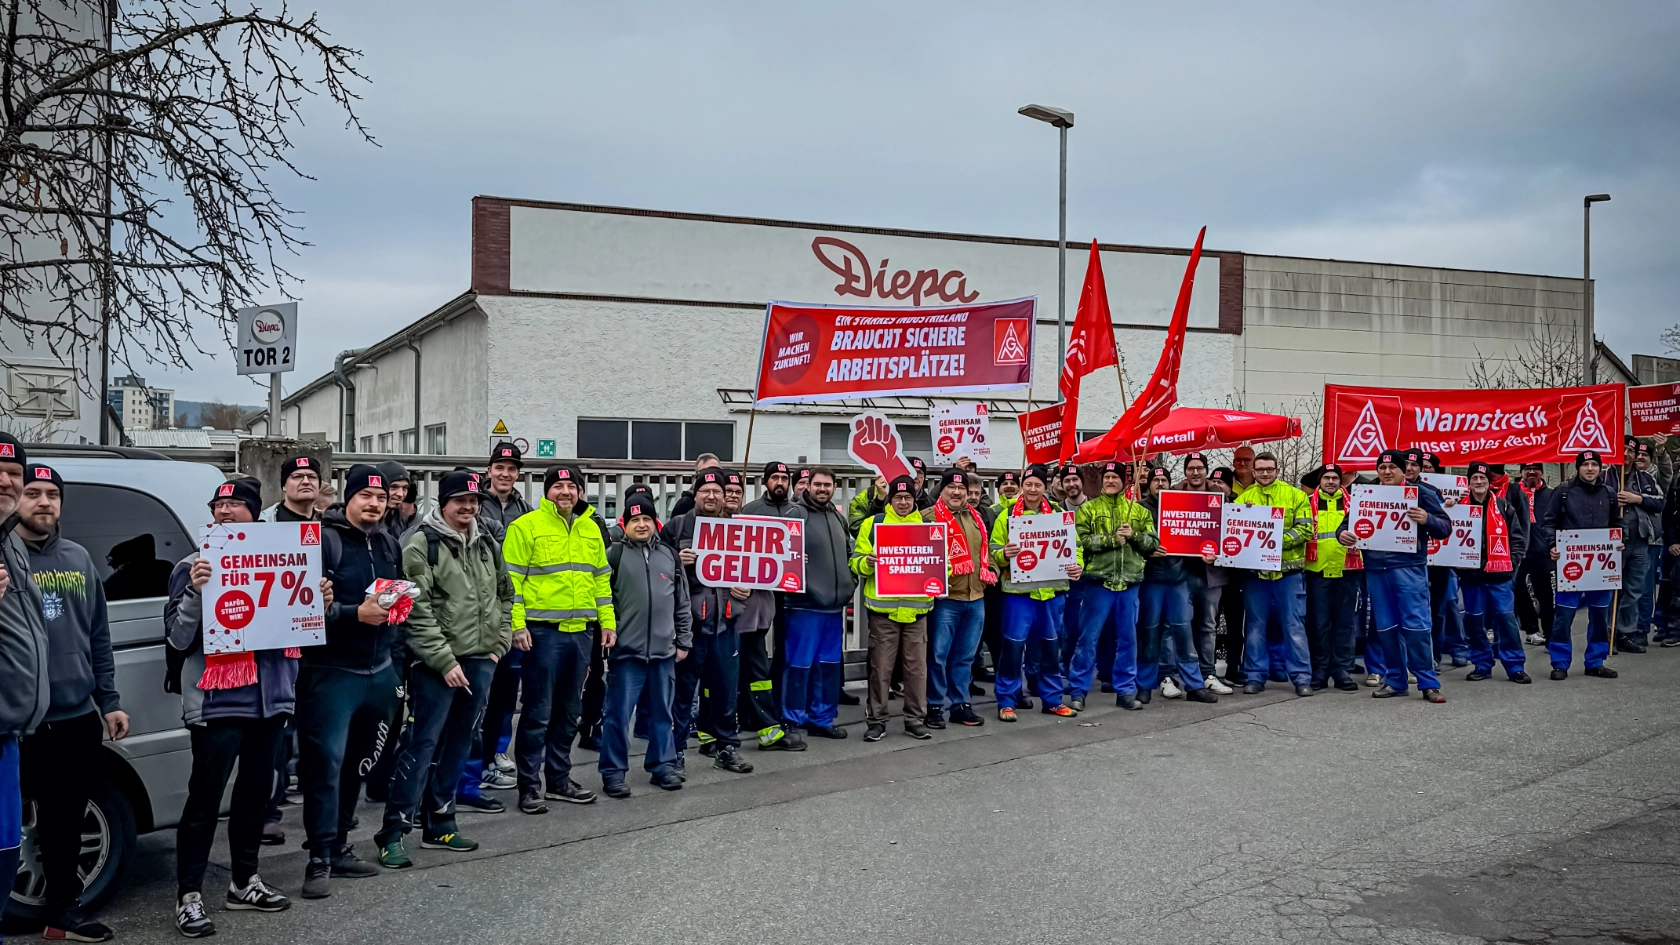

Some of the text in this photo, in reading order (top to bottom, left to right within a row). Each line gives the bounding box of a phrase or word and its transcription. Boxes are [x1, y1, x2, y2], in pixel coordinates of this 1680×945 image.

[811, 236, 980, 306] Diepa
[835, 315, 853, 326] EIN
[789, 332, 804, 344] WIR
[830, 326, 966, 351] BRAUCHT SICHERE
[777, 342, 810, 358] MACHEN
[243, 346, 290, 367] TOR 2
[772, 353, 811, 371] ZUKUNFT!
[825, 350, 965, 383] ARBEITSPLÄTZE!
[1631, 399, 1676, 409] INVESTIEREN
[939, 418, 981, 427] GEMEINSAM
[1415, 405, 1548, 432] Warnstreik
[1640, 414, 1670, 422] SPAREN.
[1153, 430, 1195, 445] Metall
[1461, 437, 1502, 455] gutes
[1503, 432, 1548, 448] Recht
[1359, 501, 1408, 510] GEMEINSAM
[1162, 510, 1211, 520] INVESTIEREN
[1358, 508, 1373, 517] FÜR
[1162, 519, 1220, 529] STATT KAPUTT-
[1227, 519, 1275, 530] GEMEINSAM
[1019, 529, 1068, 540] GEMEINSAM
[1170, 528, 1202, 536] SPAREN.
[1226, 526, 1241, 535] FÜR
[697, 522, 785, 555] MEHR
[879, 546, 933, 555] INVESTIEREN
[1020, 541, 1035, 549] FÜR
[1566, 544, 1614, 552] GEMEINSAM
[220, 553, 308, 570] GEMEINSAM
[879, 555, 943, 565] STATT KAPUTT-
[1566, 552, 1581, 560] FÜR
[701, 553, 778, 585] GELD
[889, 565, 925, 574] SPAREN.
[221, 570, 250, 587] FÜR
